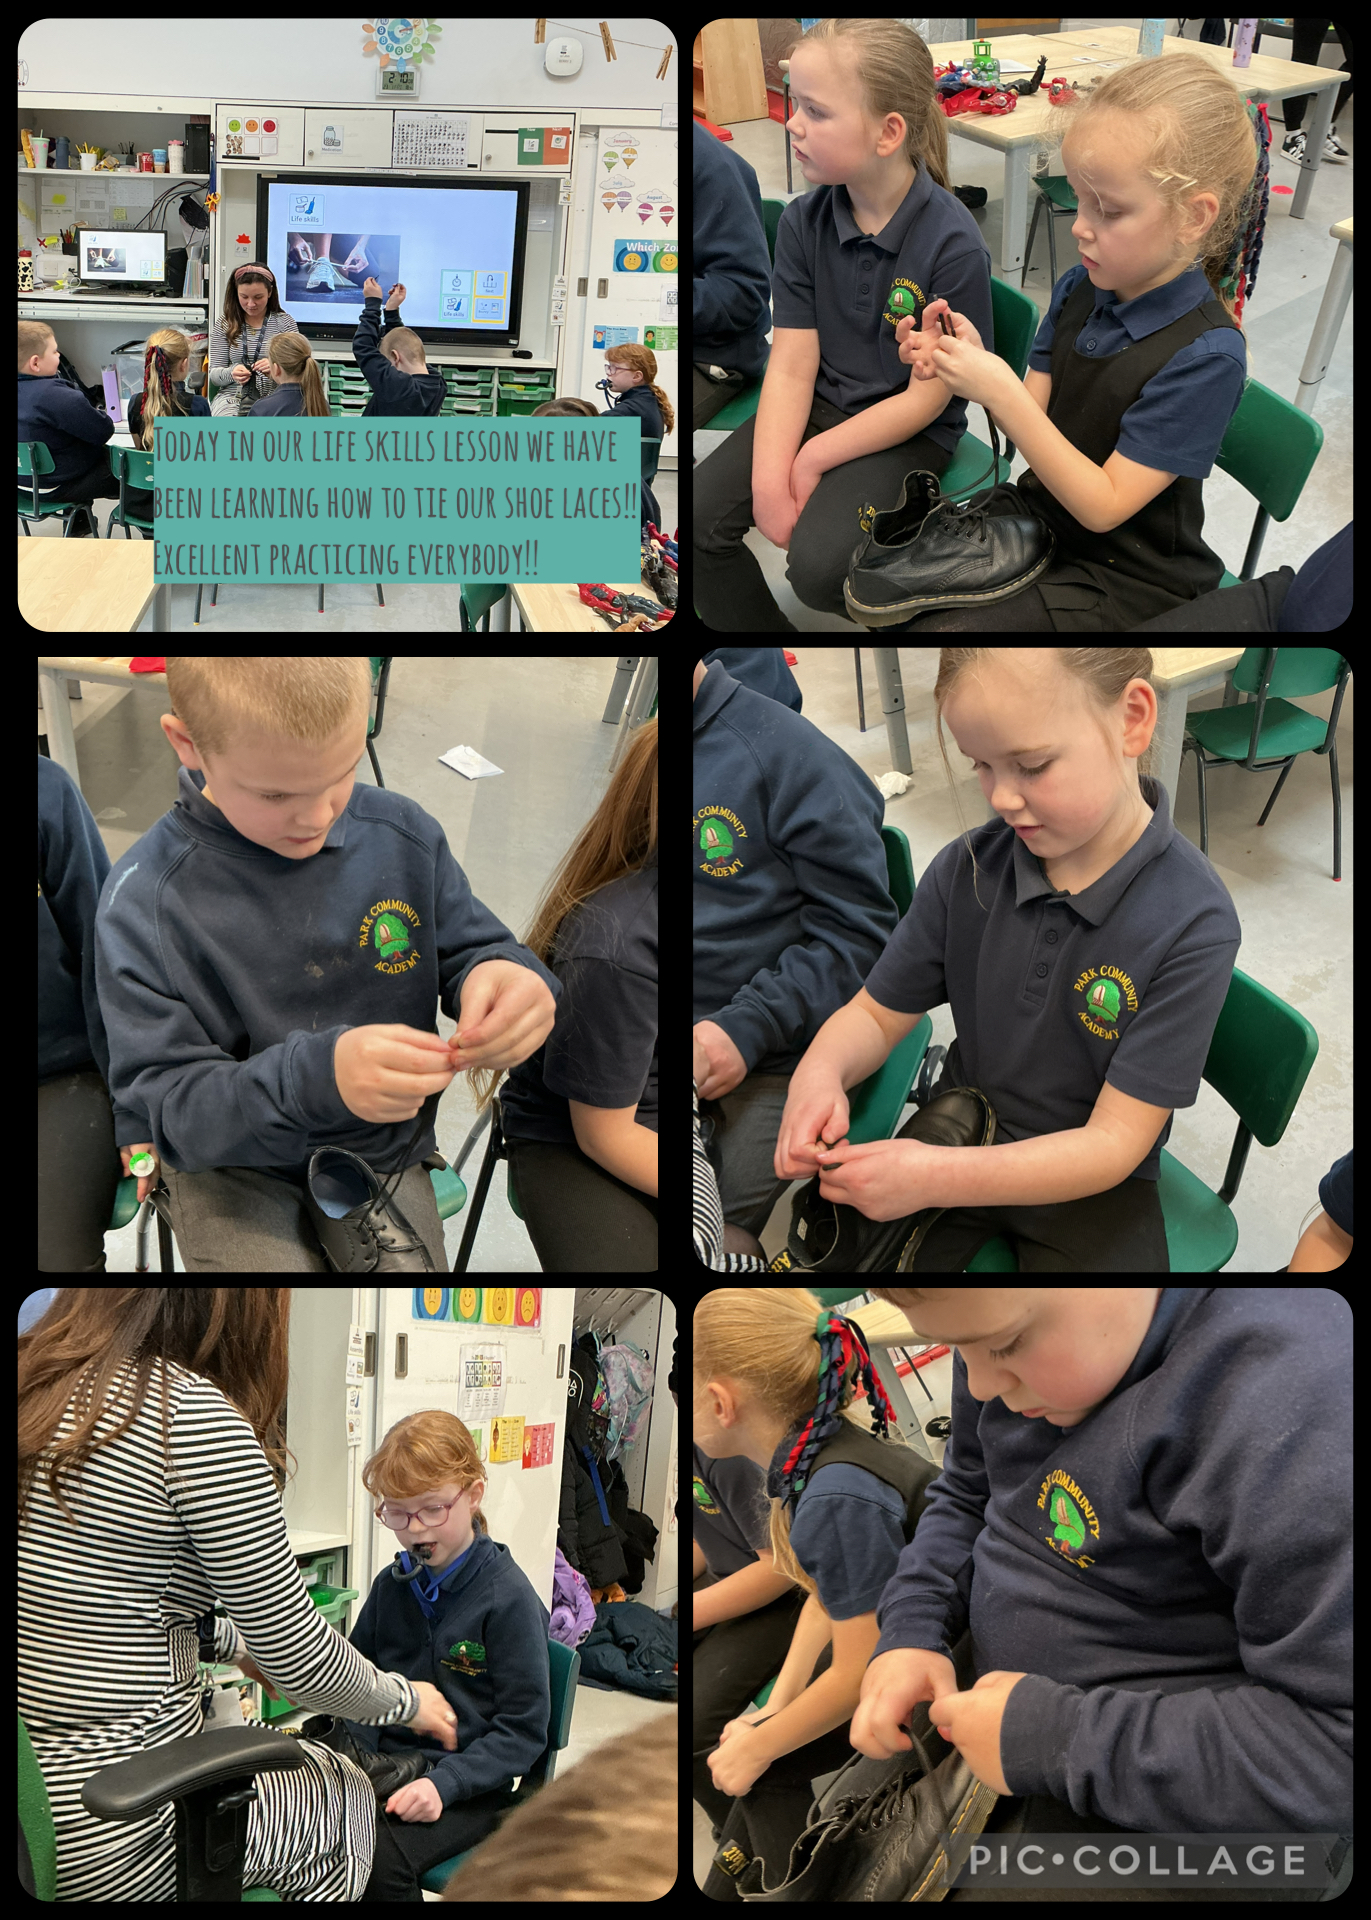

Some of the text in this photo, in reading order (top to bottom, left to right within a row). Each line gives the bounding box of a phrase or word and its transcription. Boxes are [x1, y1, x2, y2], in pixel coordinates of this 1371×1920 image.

[626, 242, 660, 252] Which
[698, 806, 748, 838] COMMUNITY
[700, 858, 744, 877] ACADEMY
[360, 899, 421, 947] PARK COMMUNITY
[374, 950, 421, 974] ACADEMY
[1074, 965, 1138, 1012] PARK COMMUNITY
[1078, 1012, 1119, 1040] ACADEMY
[1052, 1469, 1100, 1540] COMMUNITY
